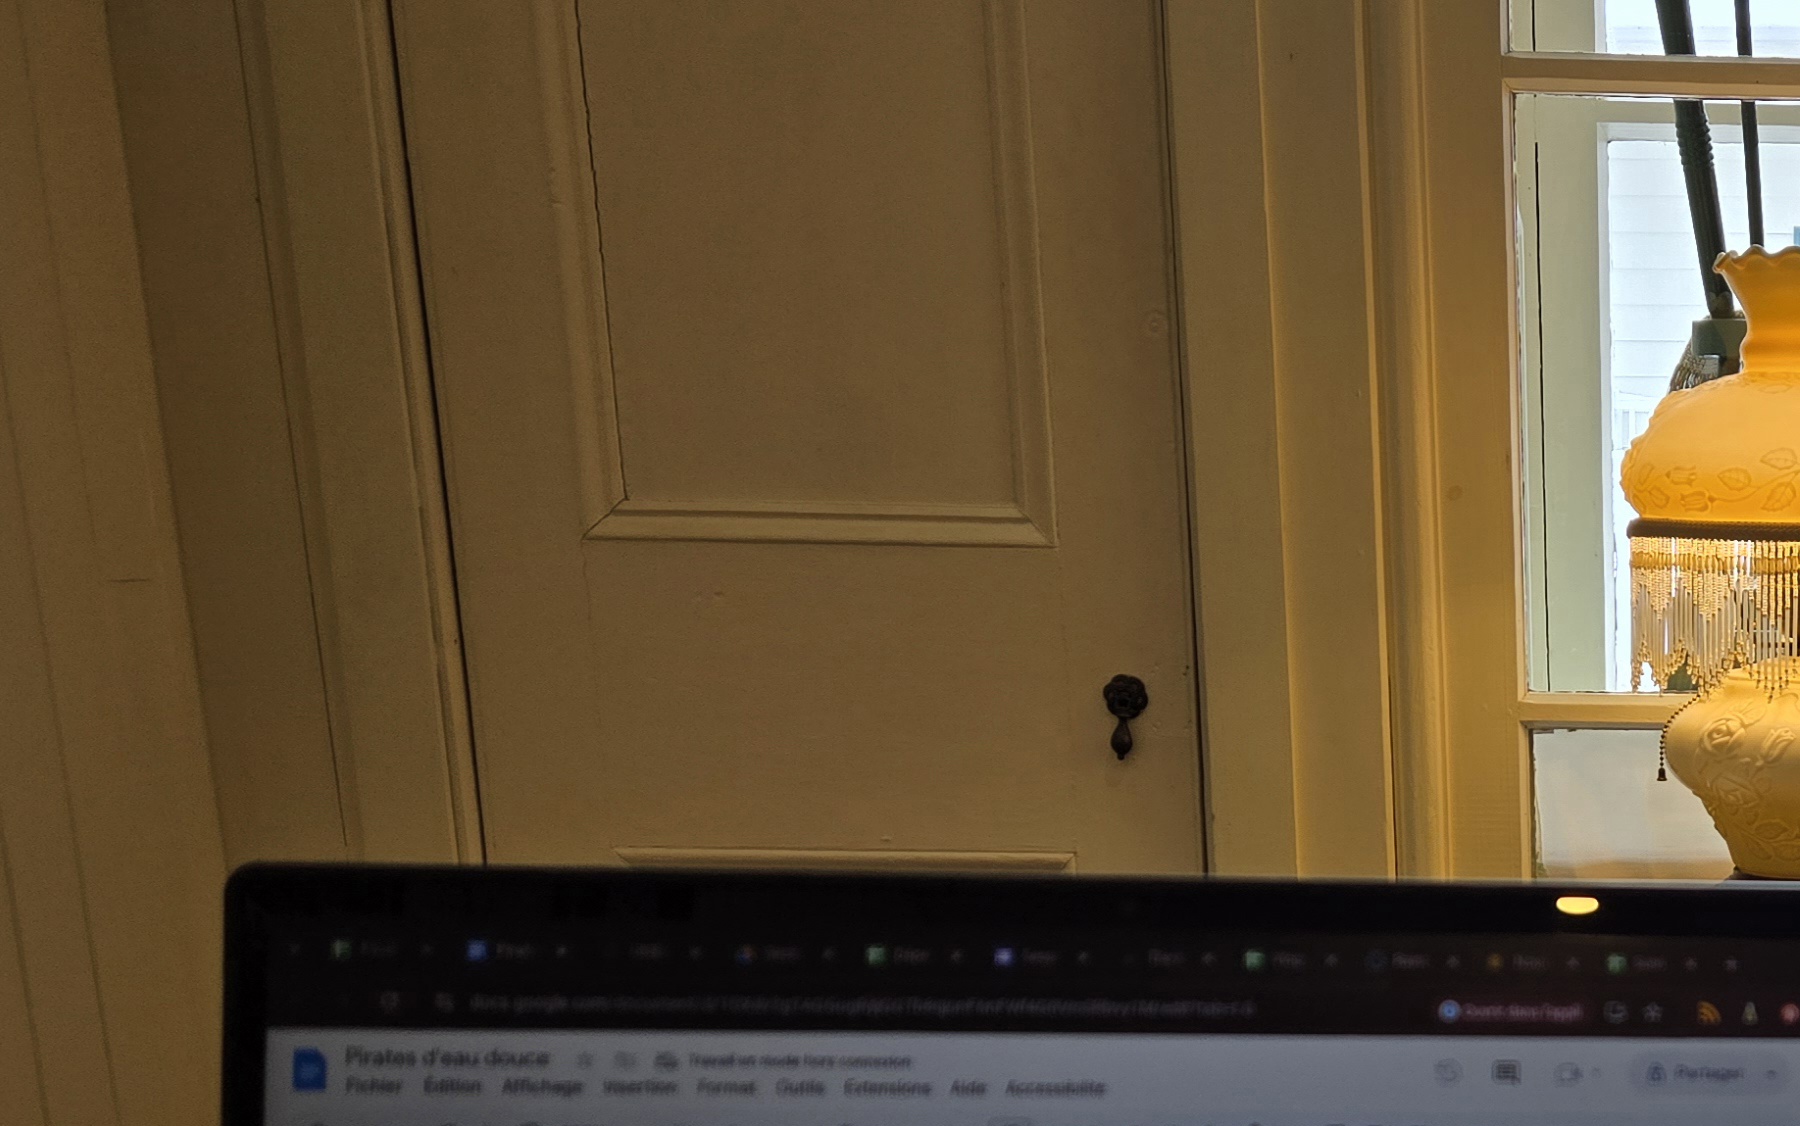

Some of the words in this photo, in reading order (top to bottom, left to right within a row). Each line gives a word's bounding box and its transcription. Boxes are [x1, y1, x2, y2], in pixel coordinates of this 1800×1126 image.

[345, 1045, 415, 1067] Pirates
[422, 1045, 479, 1067] d'eau
[484, 1045, 550, 1067] douce
[345, 1077, 402, 1095] Fichier
[501, 1078, 583, 1099] Affichage
[603, 1079, 679, 1096] Insertion
[696, 1079, 756, 1096] Format
[775, 1079, 824, 1096] Outils
[843, 1079, 932, 1097] Extensions
[950, 1079, 986, 1097] Aide
